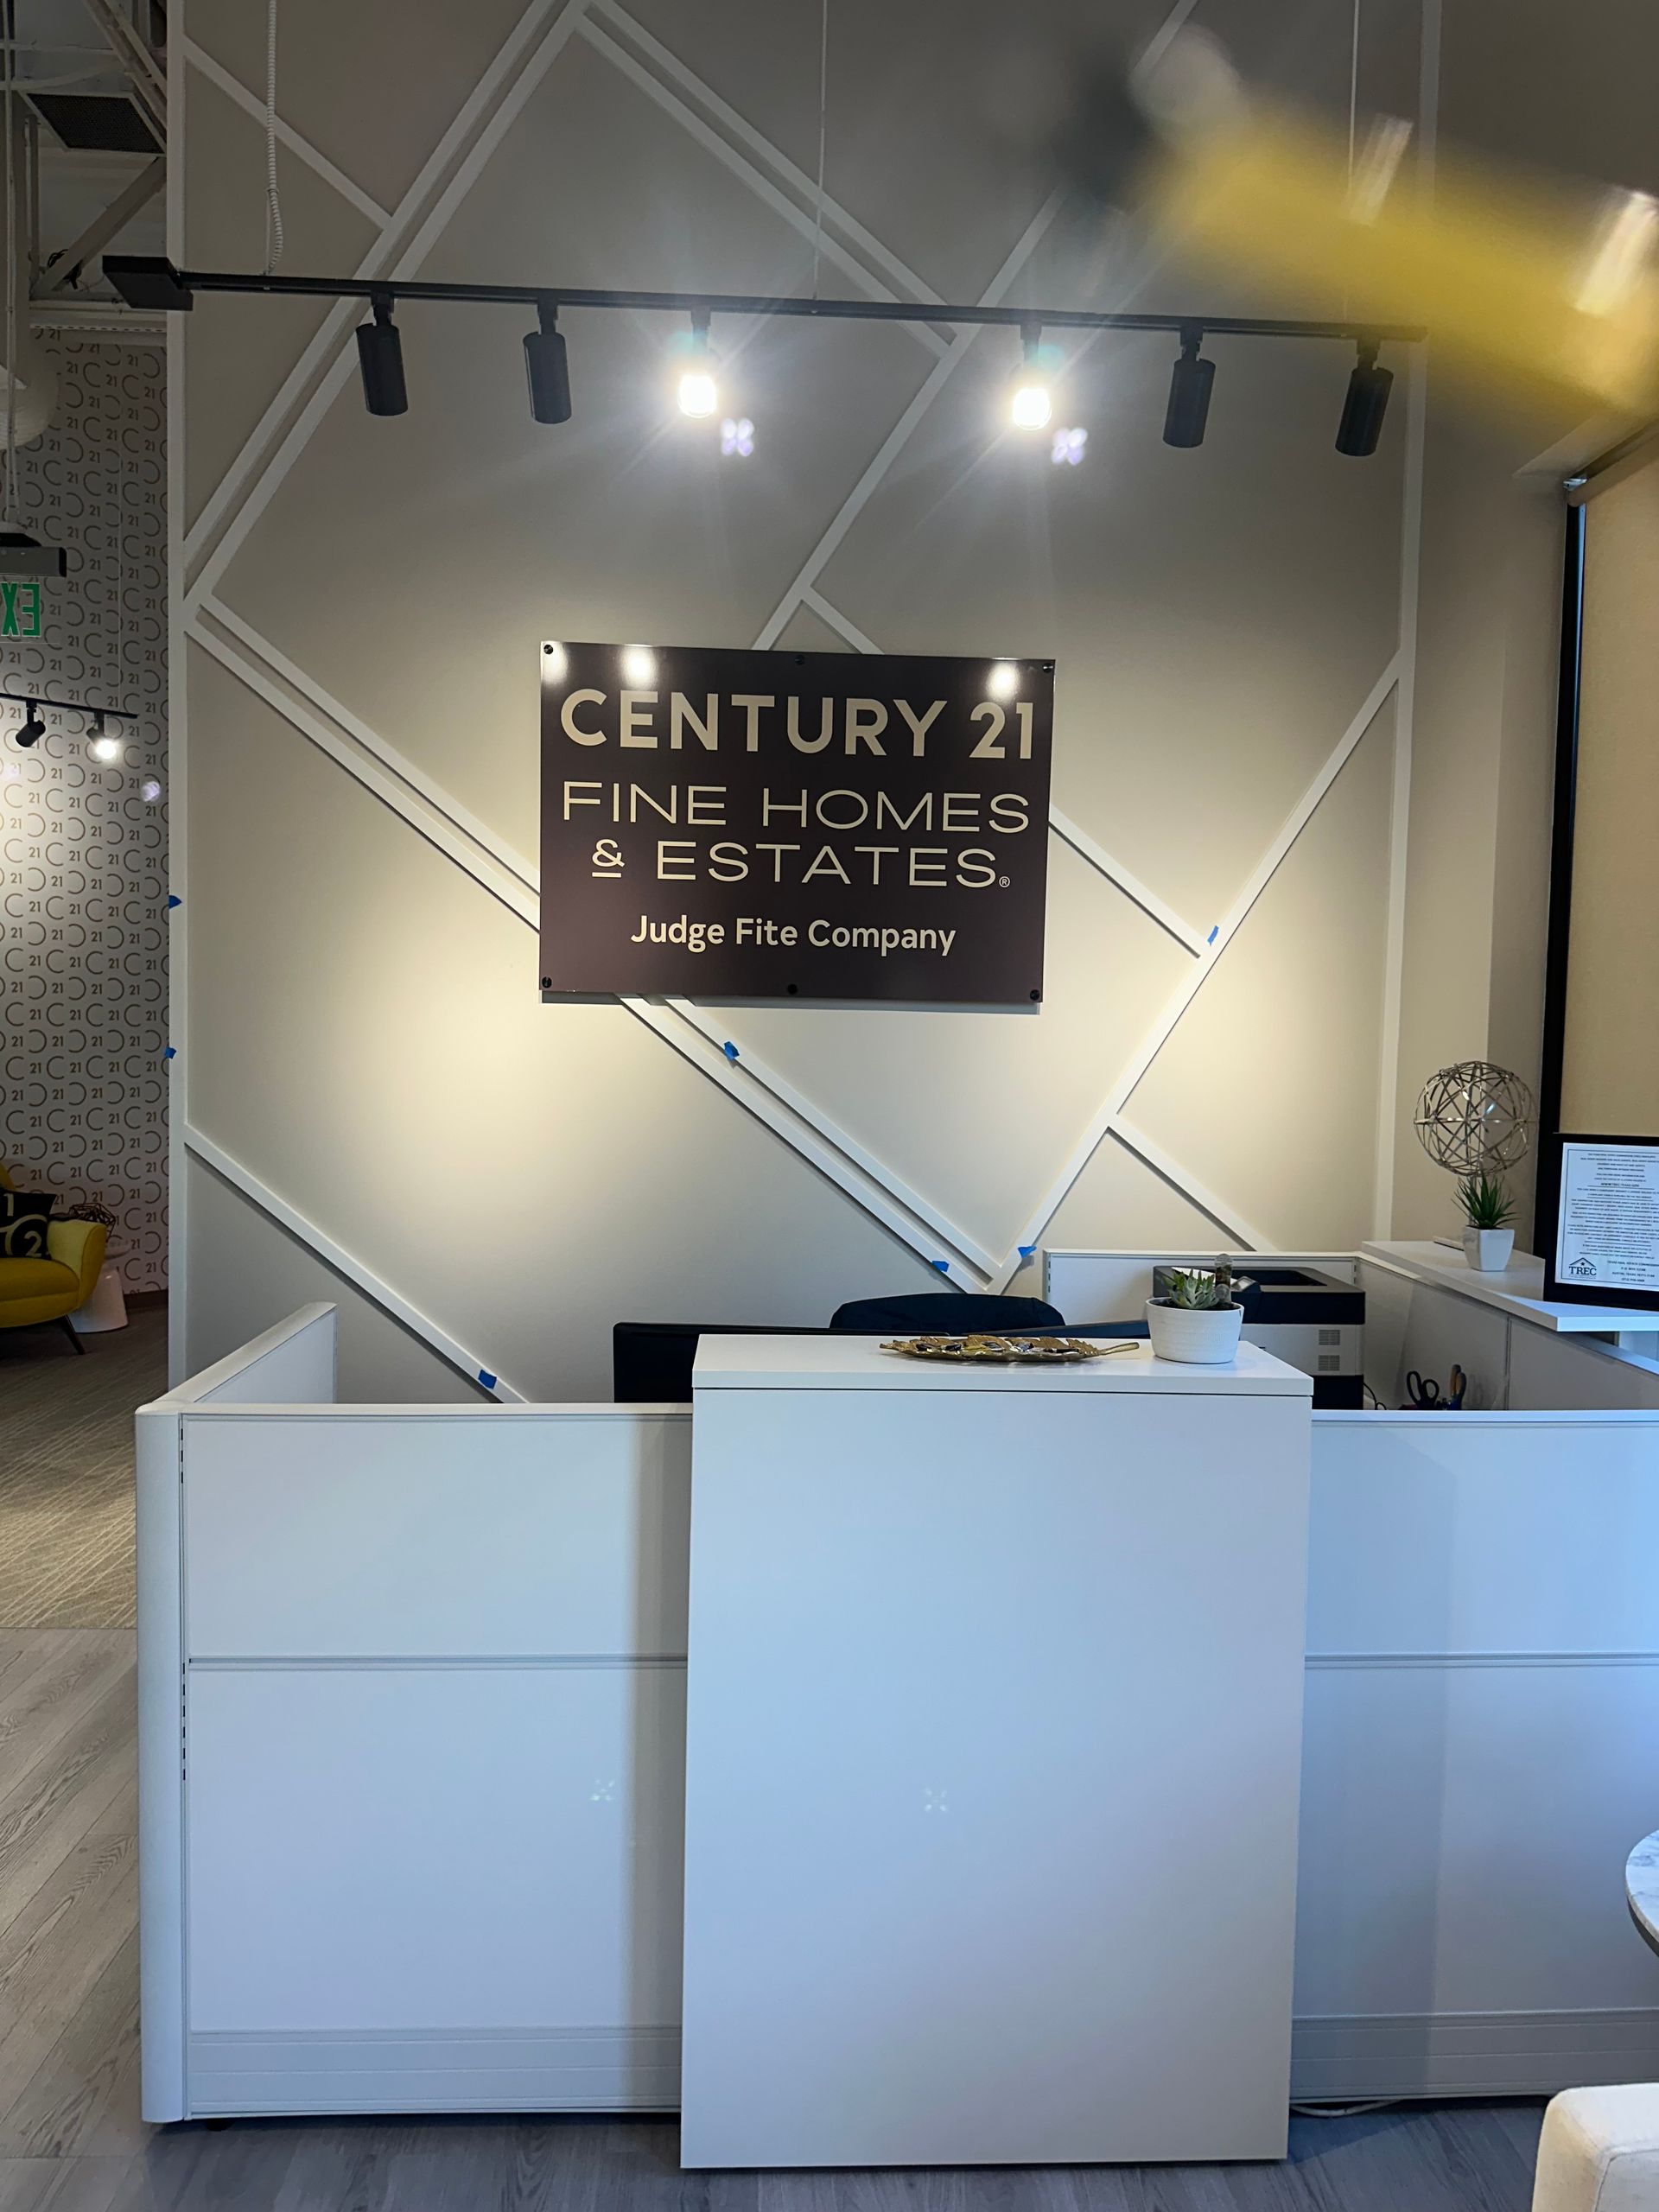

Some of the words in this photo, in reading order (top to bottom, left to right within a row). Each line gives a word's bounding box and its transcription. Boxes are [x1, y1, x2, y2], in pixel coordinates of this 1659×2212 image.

[561, 688, 947, 757] CENTURY
[969, 701, 1033, 760] 21
[563, 781, 727, 826] FINE
[762, 787, 1030, 834] HOMES
[591, 838, 626, 879] &
[631, 914, 725, 954] Judge
[735, 918, 798, 946] Fite
[807, 919, 957, 957] Company
[1569, 1266, 1597, 1276] TREC
